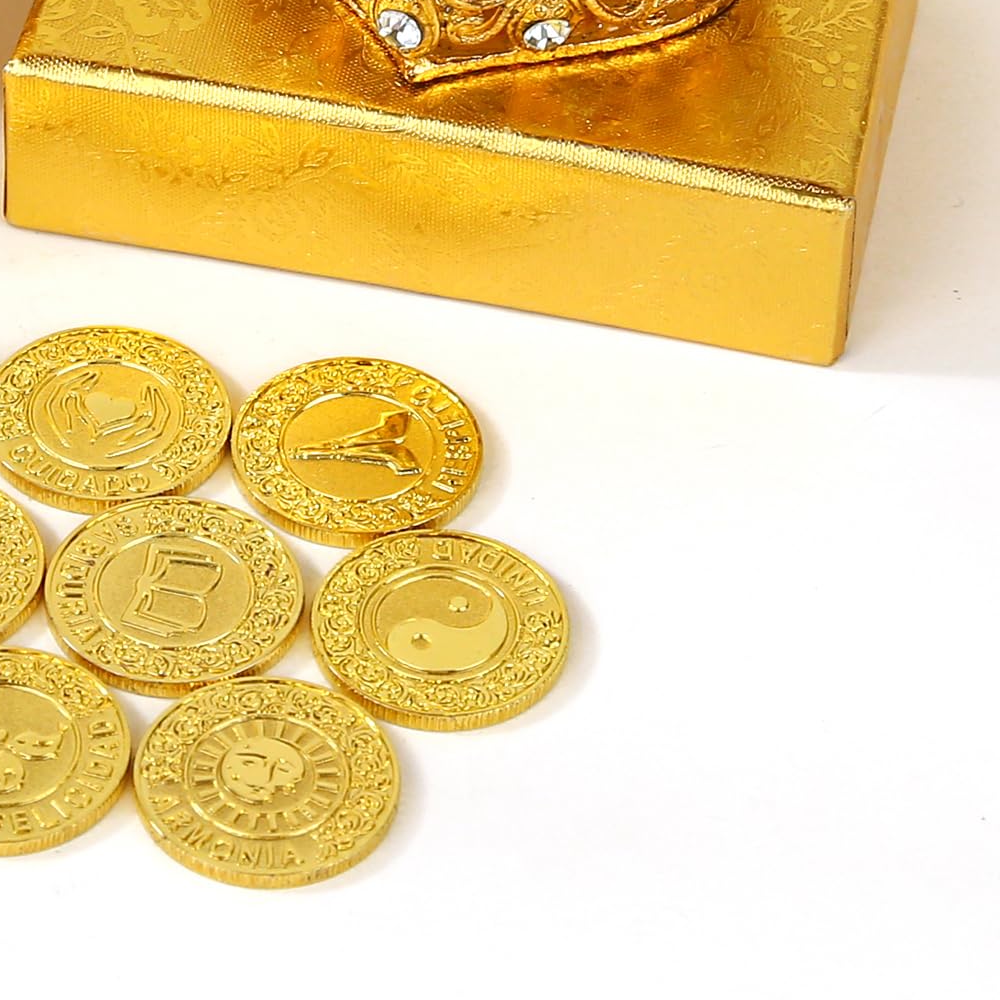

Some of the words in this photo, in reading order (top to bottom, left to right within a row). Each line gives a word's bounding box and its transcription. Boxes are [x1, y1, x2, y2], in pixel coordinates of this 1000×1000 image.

[10, 445, 150, 496] CUIDADO
[409, 385, 473, 494] RESPETO
[56, 515, 139, 643] SABIDURIA
[432, 540, 550, 607] UNIDAD
[150, 796, 305, 869] ARMONIA
